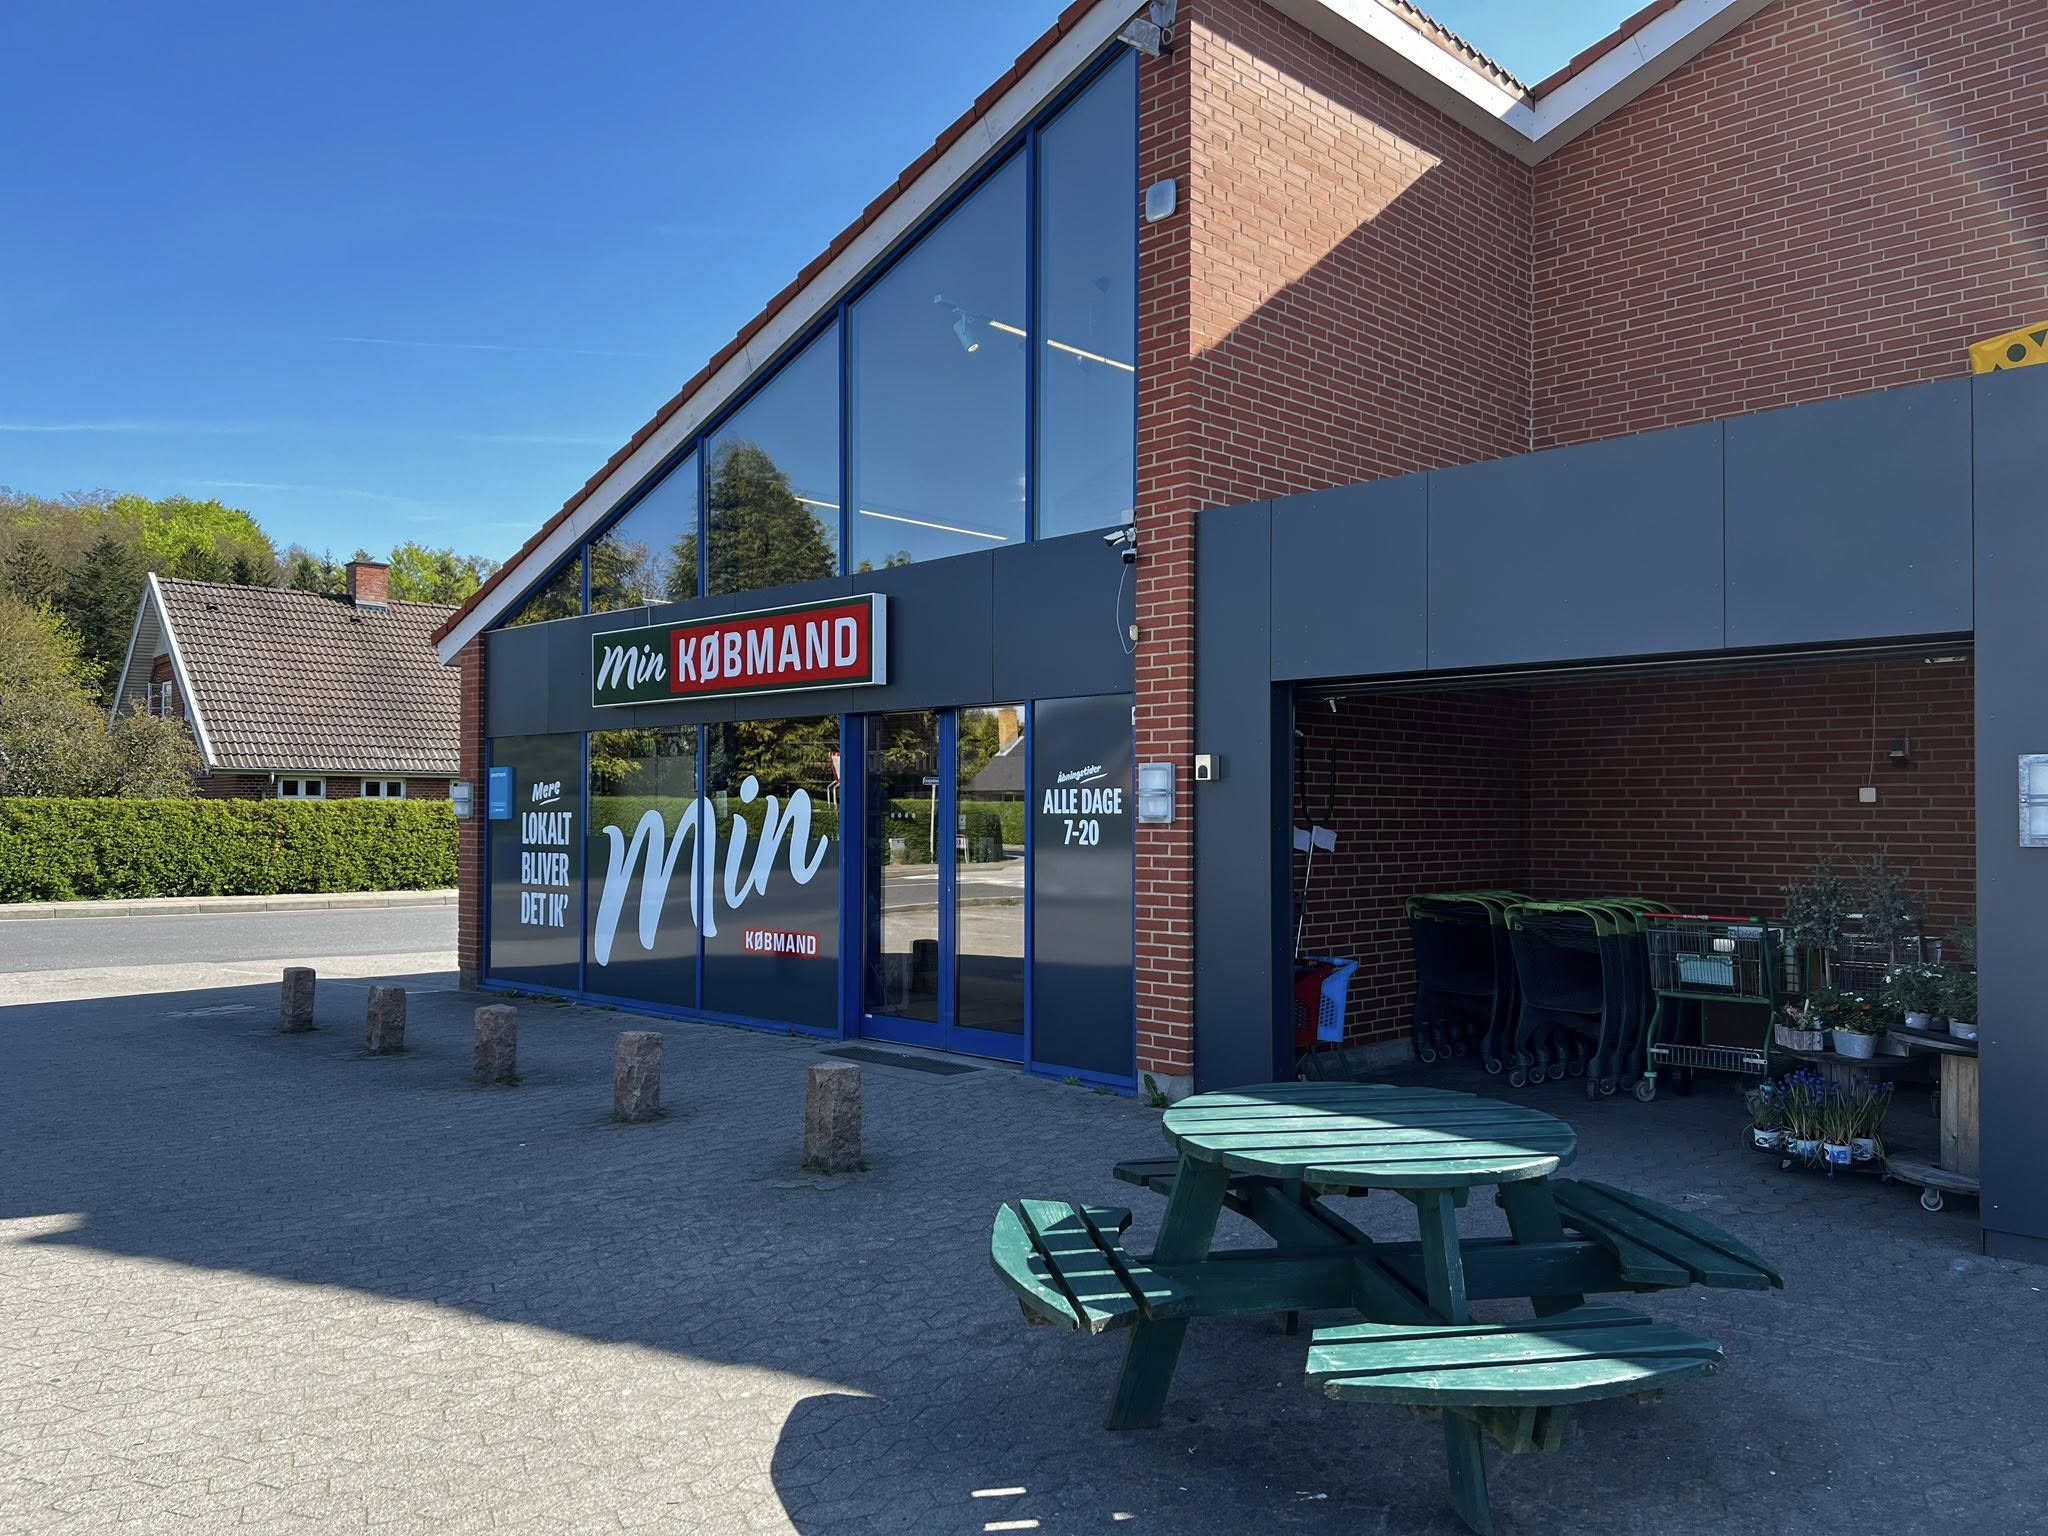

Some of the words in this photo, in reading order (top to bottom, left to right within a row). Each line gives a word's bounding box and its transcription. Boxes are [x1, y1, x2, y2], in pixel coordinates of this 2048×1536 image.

[597, 645, 666, 691] Min
[678, 616, 857, 683] KØBMAND
[532, 780, 561, 802] Mere
[1043, 788, 1078, 814] ALLE
[1081, 788, 1122, 814] DAGE
[521, 811, 572, 845] LOKALT
[1063, 819, 1099, 845] 7-20
[521, 851, 569, 886] BLIVER
[594, 775, 828, 966] Min
[520, 891, 546, 926] DET
[745, 930, 816, 955] KØBMAND
